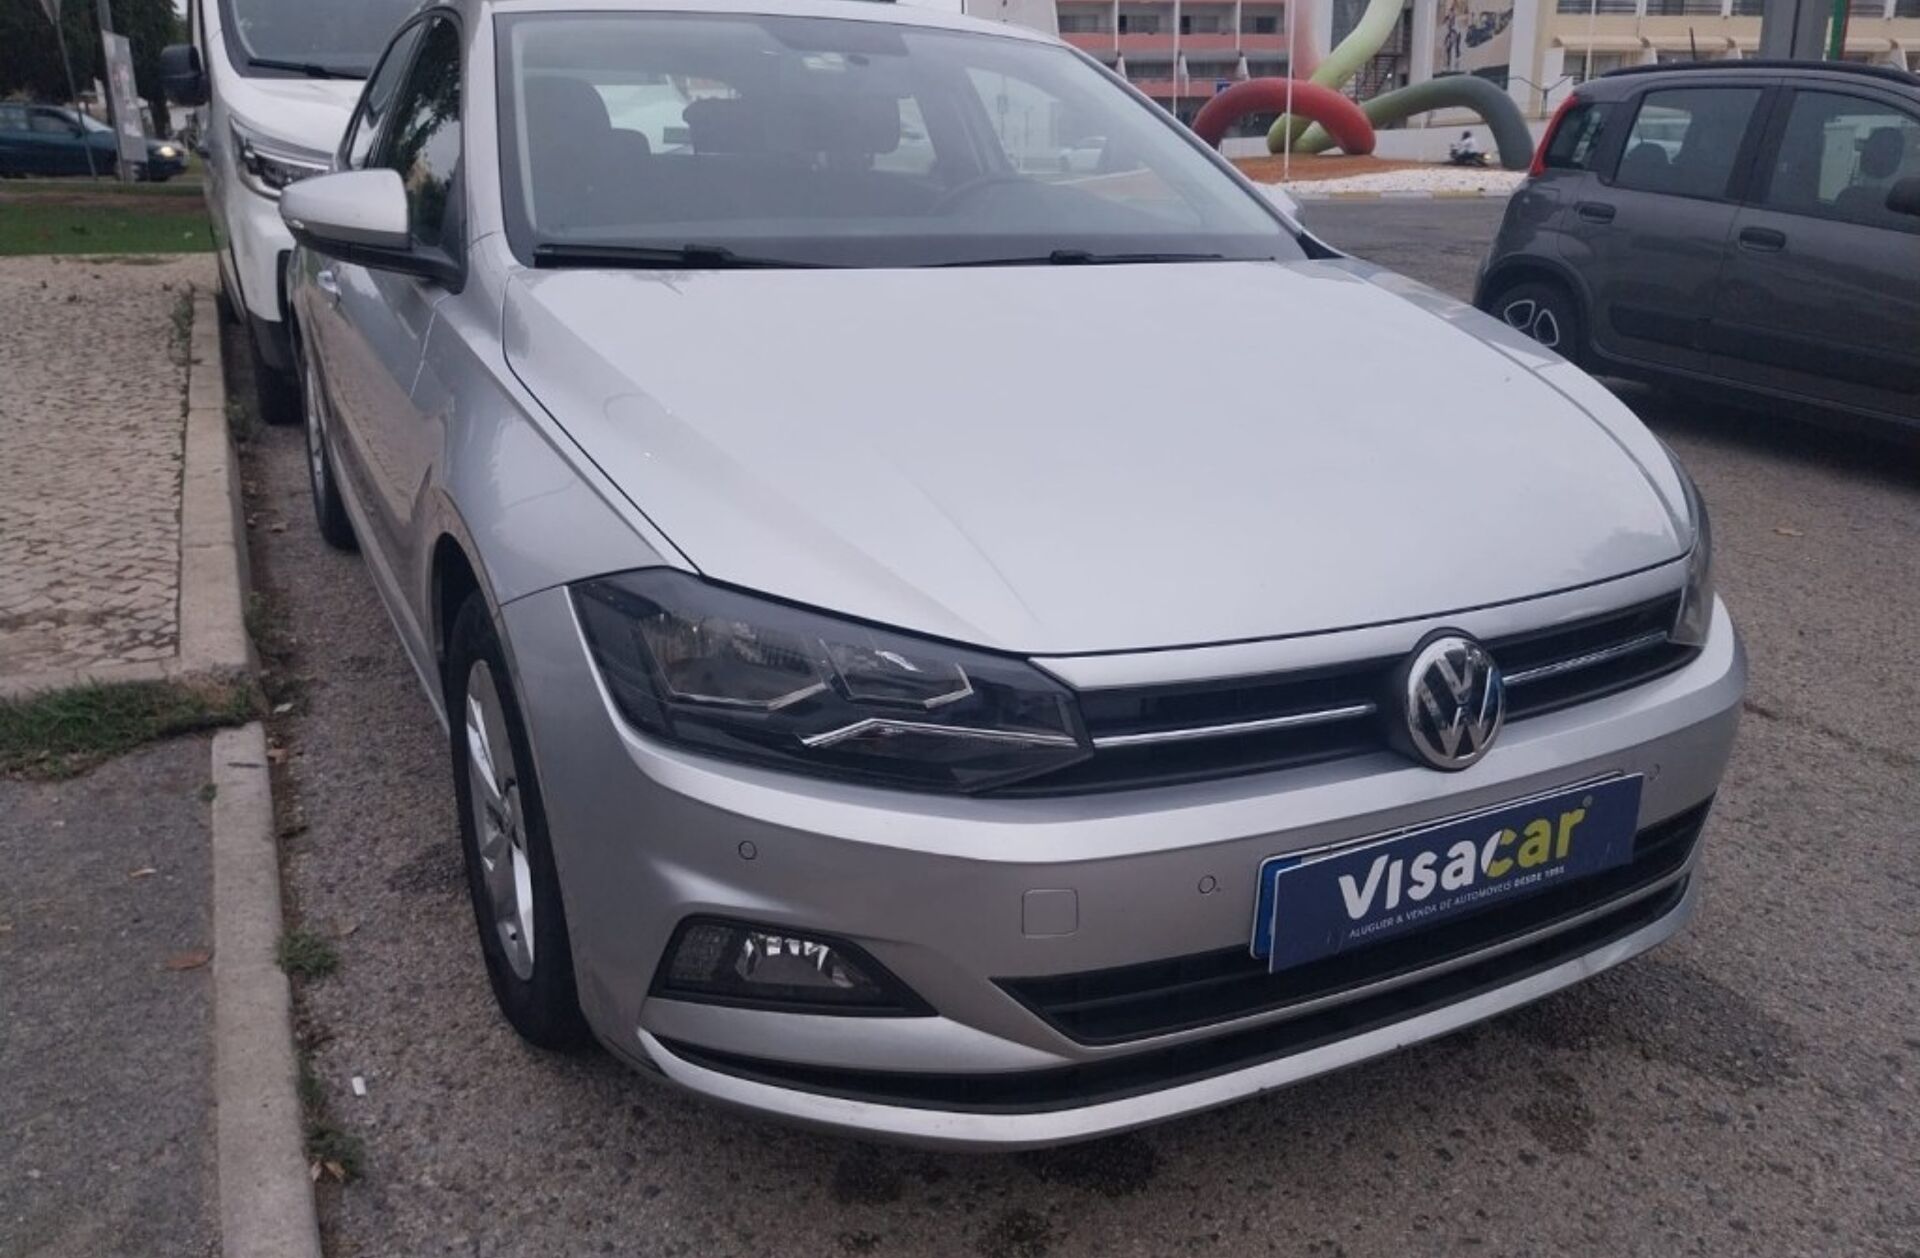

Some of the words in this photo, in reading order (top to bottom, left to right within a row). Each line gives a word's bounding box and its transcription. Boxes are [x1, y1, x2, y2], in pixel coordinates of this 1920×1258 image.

[1405, 903, 1437, 921] VENDA
[1439, 898, 1453, 912] DE
[1513, 871, 1543, 888] DESDE
